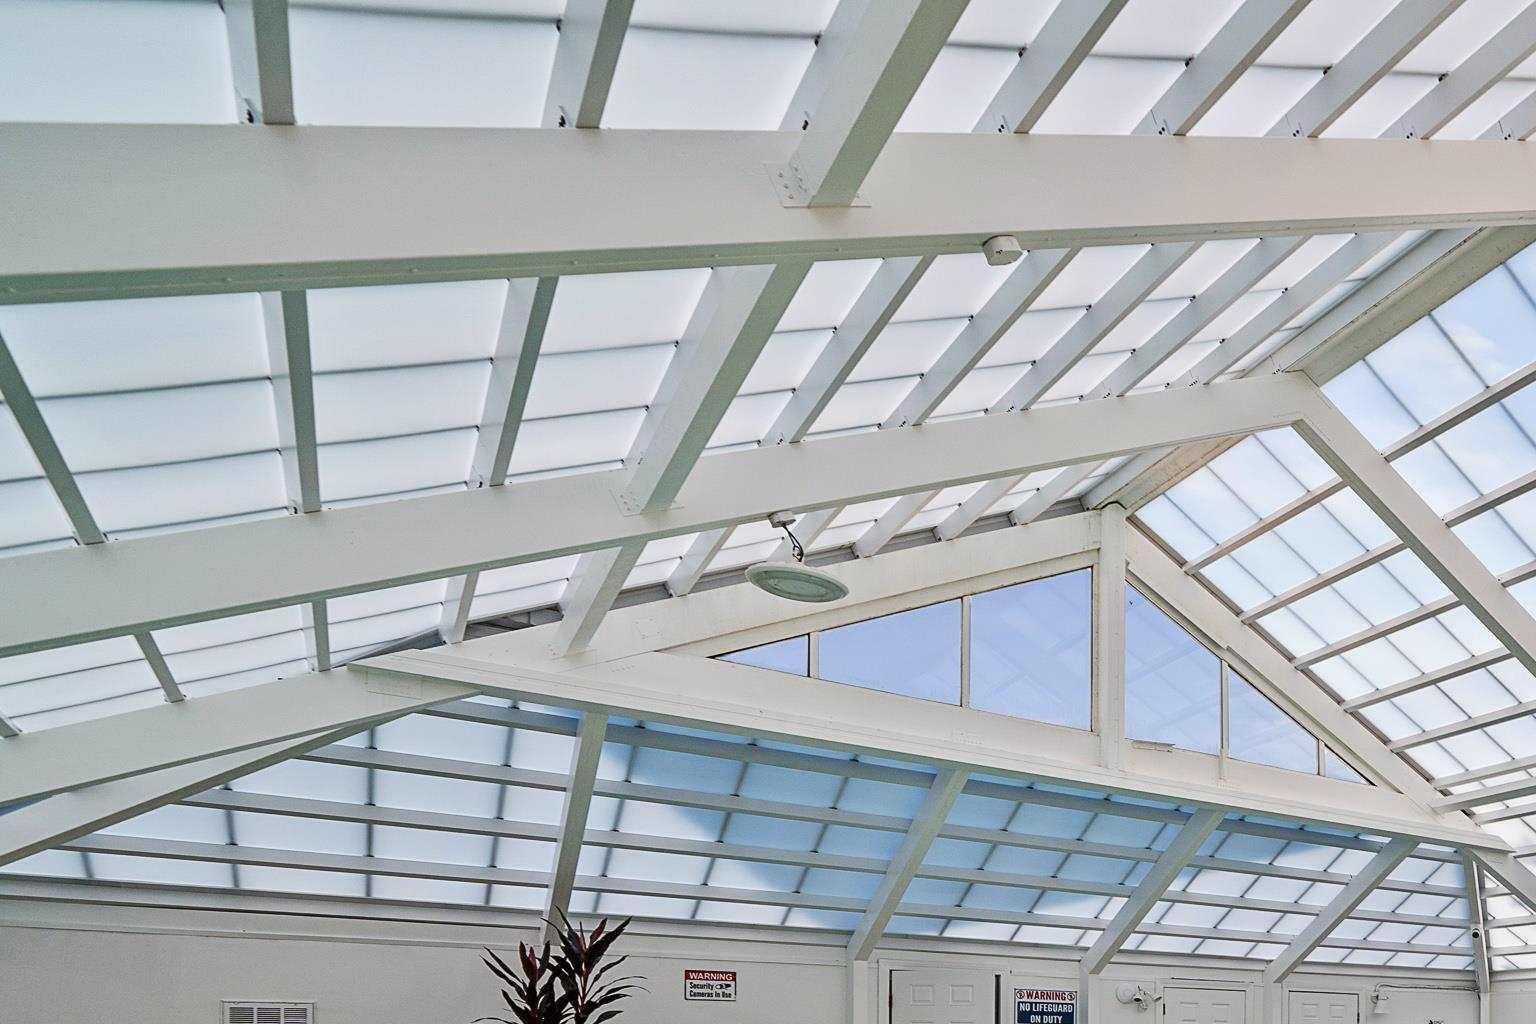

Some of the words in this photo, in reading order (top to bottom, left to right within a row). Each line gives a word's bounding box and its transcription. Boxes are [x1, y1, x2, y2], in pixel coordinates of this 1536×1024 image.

[689, 972, 733, 980] WARNING
[689, 982, 714, 990] Security
[690, 990, 713, 998] Cameras
[1026, 991, 1066, 1001] WARNING
[1020, 1003, 1031, 1011] NO
[1033, 1003, 1073, 1012] LIFEGUARD
[1031, 1015, 1041, 1023] ON
[1043, 1016, 1063, 1024] DUTY
